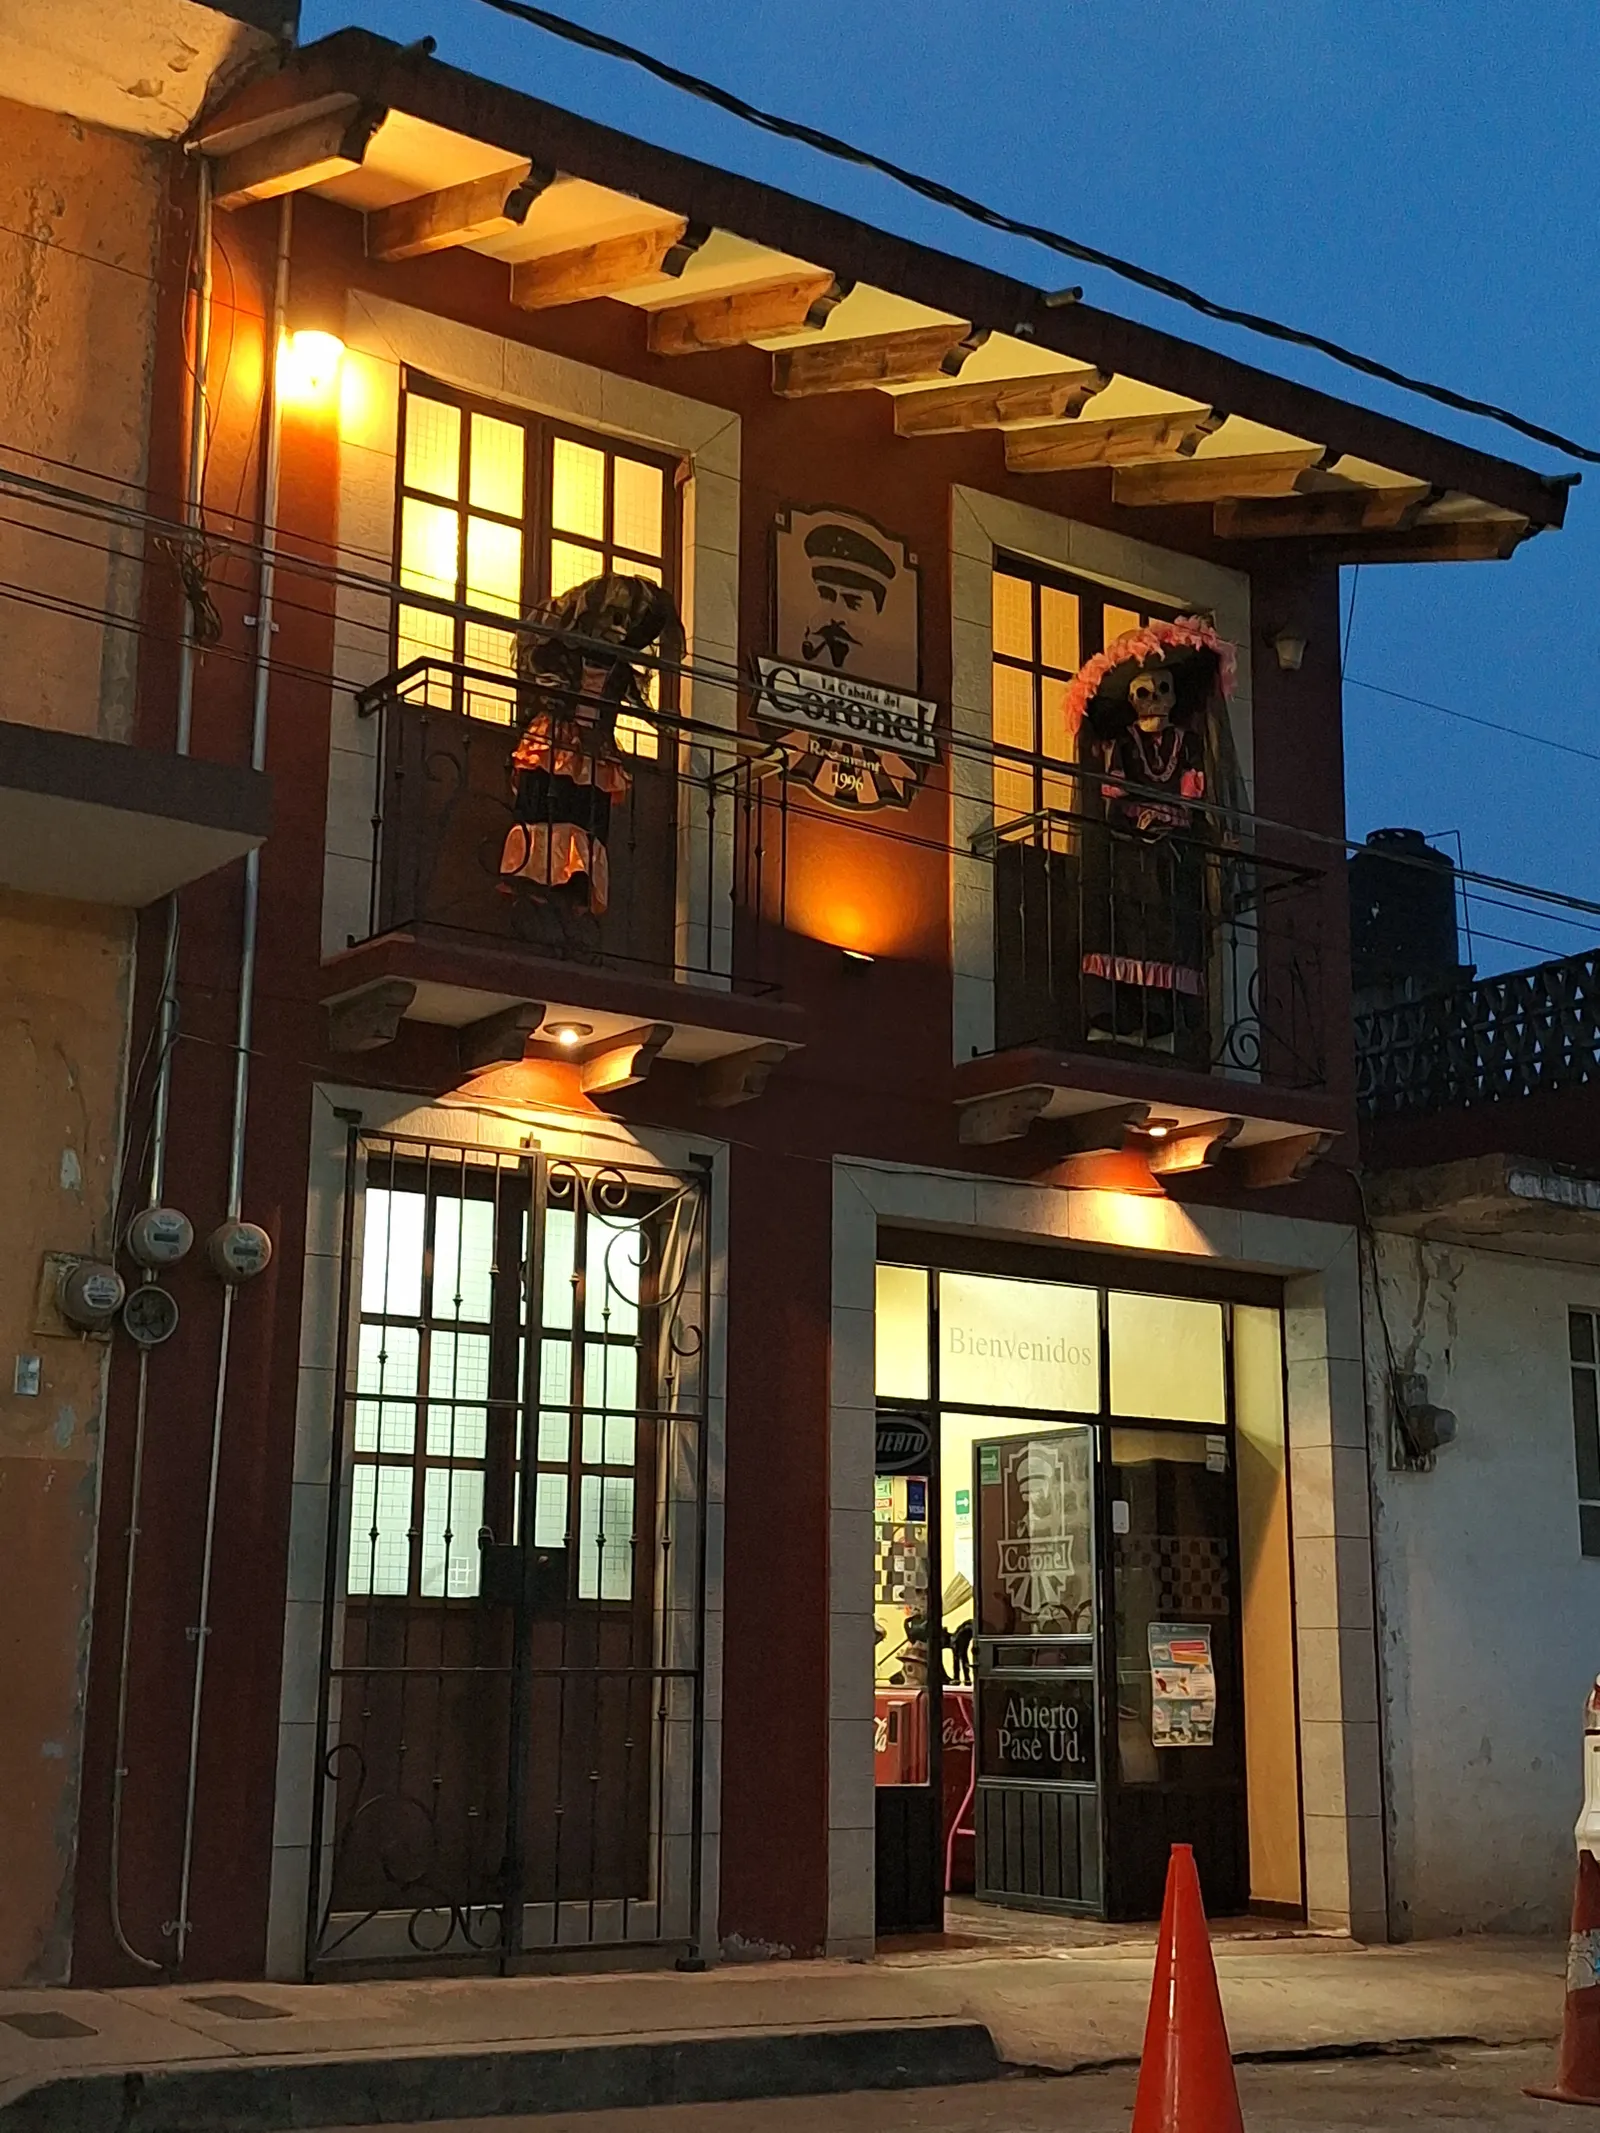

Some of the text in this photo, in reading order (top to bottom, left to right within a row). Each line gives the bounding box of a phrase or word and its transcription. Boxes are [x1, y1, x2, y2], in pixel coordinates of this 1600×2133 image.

[766, 667, 930, 748] Coronel
[821, 677, 900, 708] La Cabaña del
[833, 771, 864, 791] 1996
[949, 1327, 1092, 1367] Bienvenidos
[874, 1431, 926, 1453] IERTO
[1005, 1543, 1068, 1571] Coronel
[1003, 1697, 1079, 1729] Abierto
[1049, 1730, 1086, 1763] Ud.
